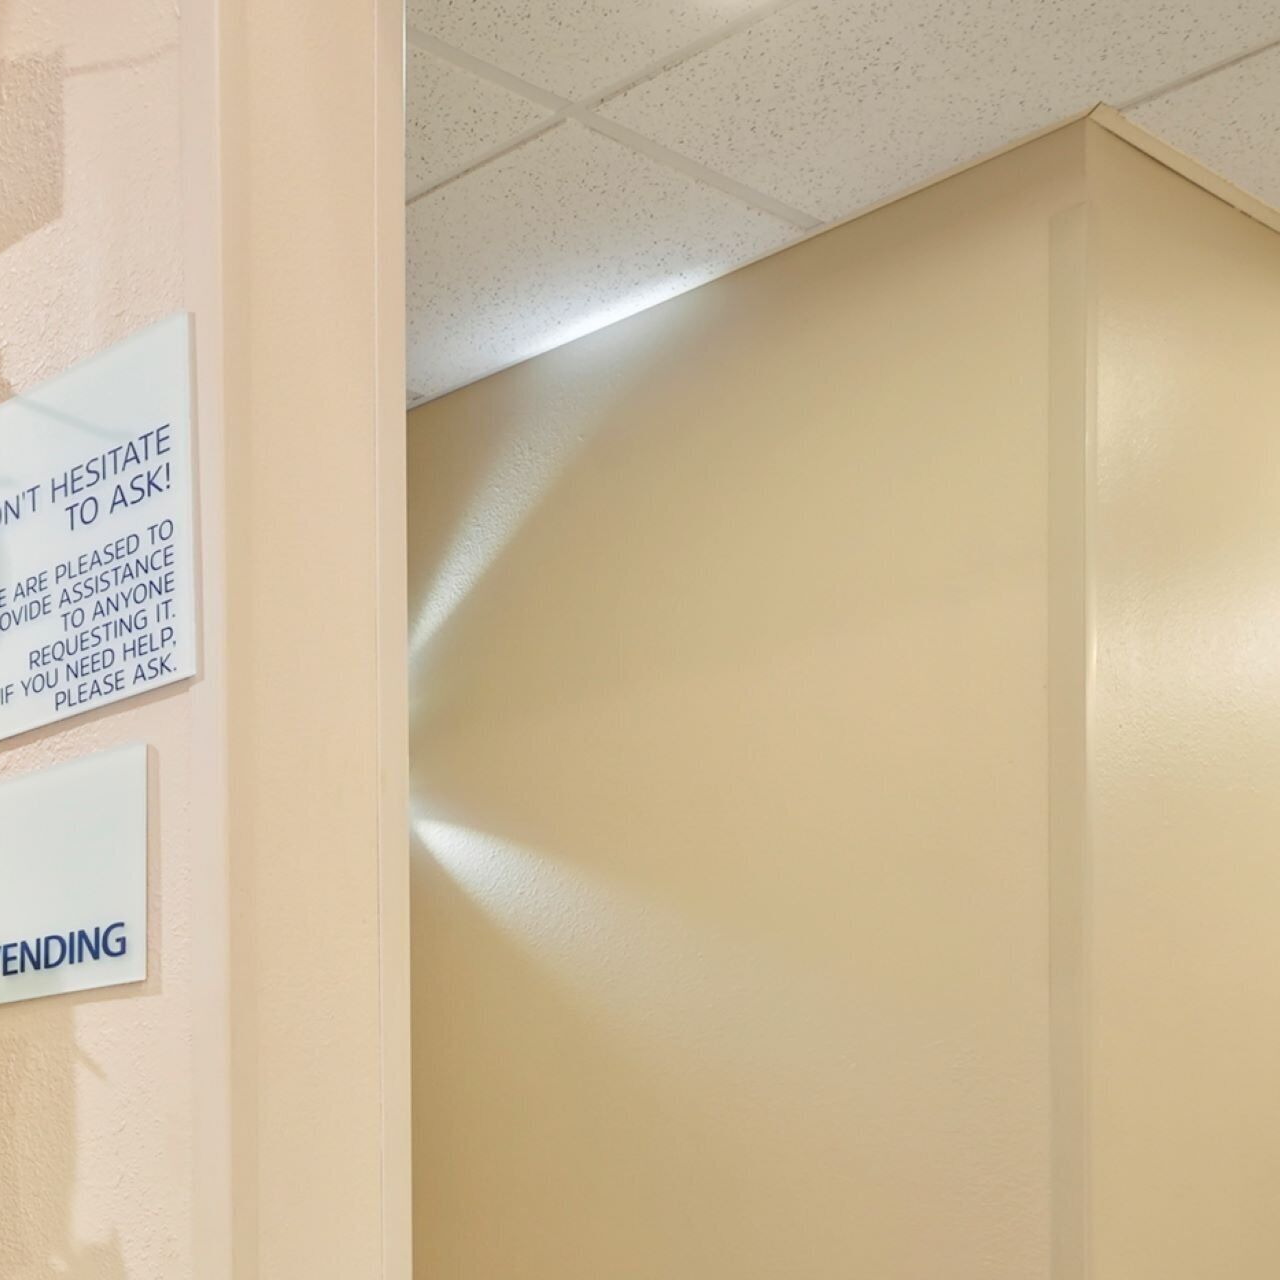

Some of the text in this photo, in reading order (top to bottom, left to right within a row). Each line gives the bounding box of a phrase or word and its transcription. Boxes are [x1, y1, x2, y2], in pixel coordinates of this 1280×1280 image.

[51, 424, 171, 503] HESITATE
[65, 463, 171, 531] TO ASK!
[13, 571, 48, 602] ARE
[55, 534, 139, 584] PLEASED
[147, 519, 174, 542] TO
[59, 545, 175, 609] ASSISTANCE
[29, 599, 176, 670] REQUESTING IT.
[61, 572, 175, 632] TO ANYONE
[0, 687, 15, 705] IF
[21, 668, 59, 697] YOU
[66, 648, 115, 682] NEED
[55, 653, 177, 711] PLEASE ASK.
